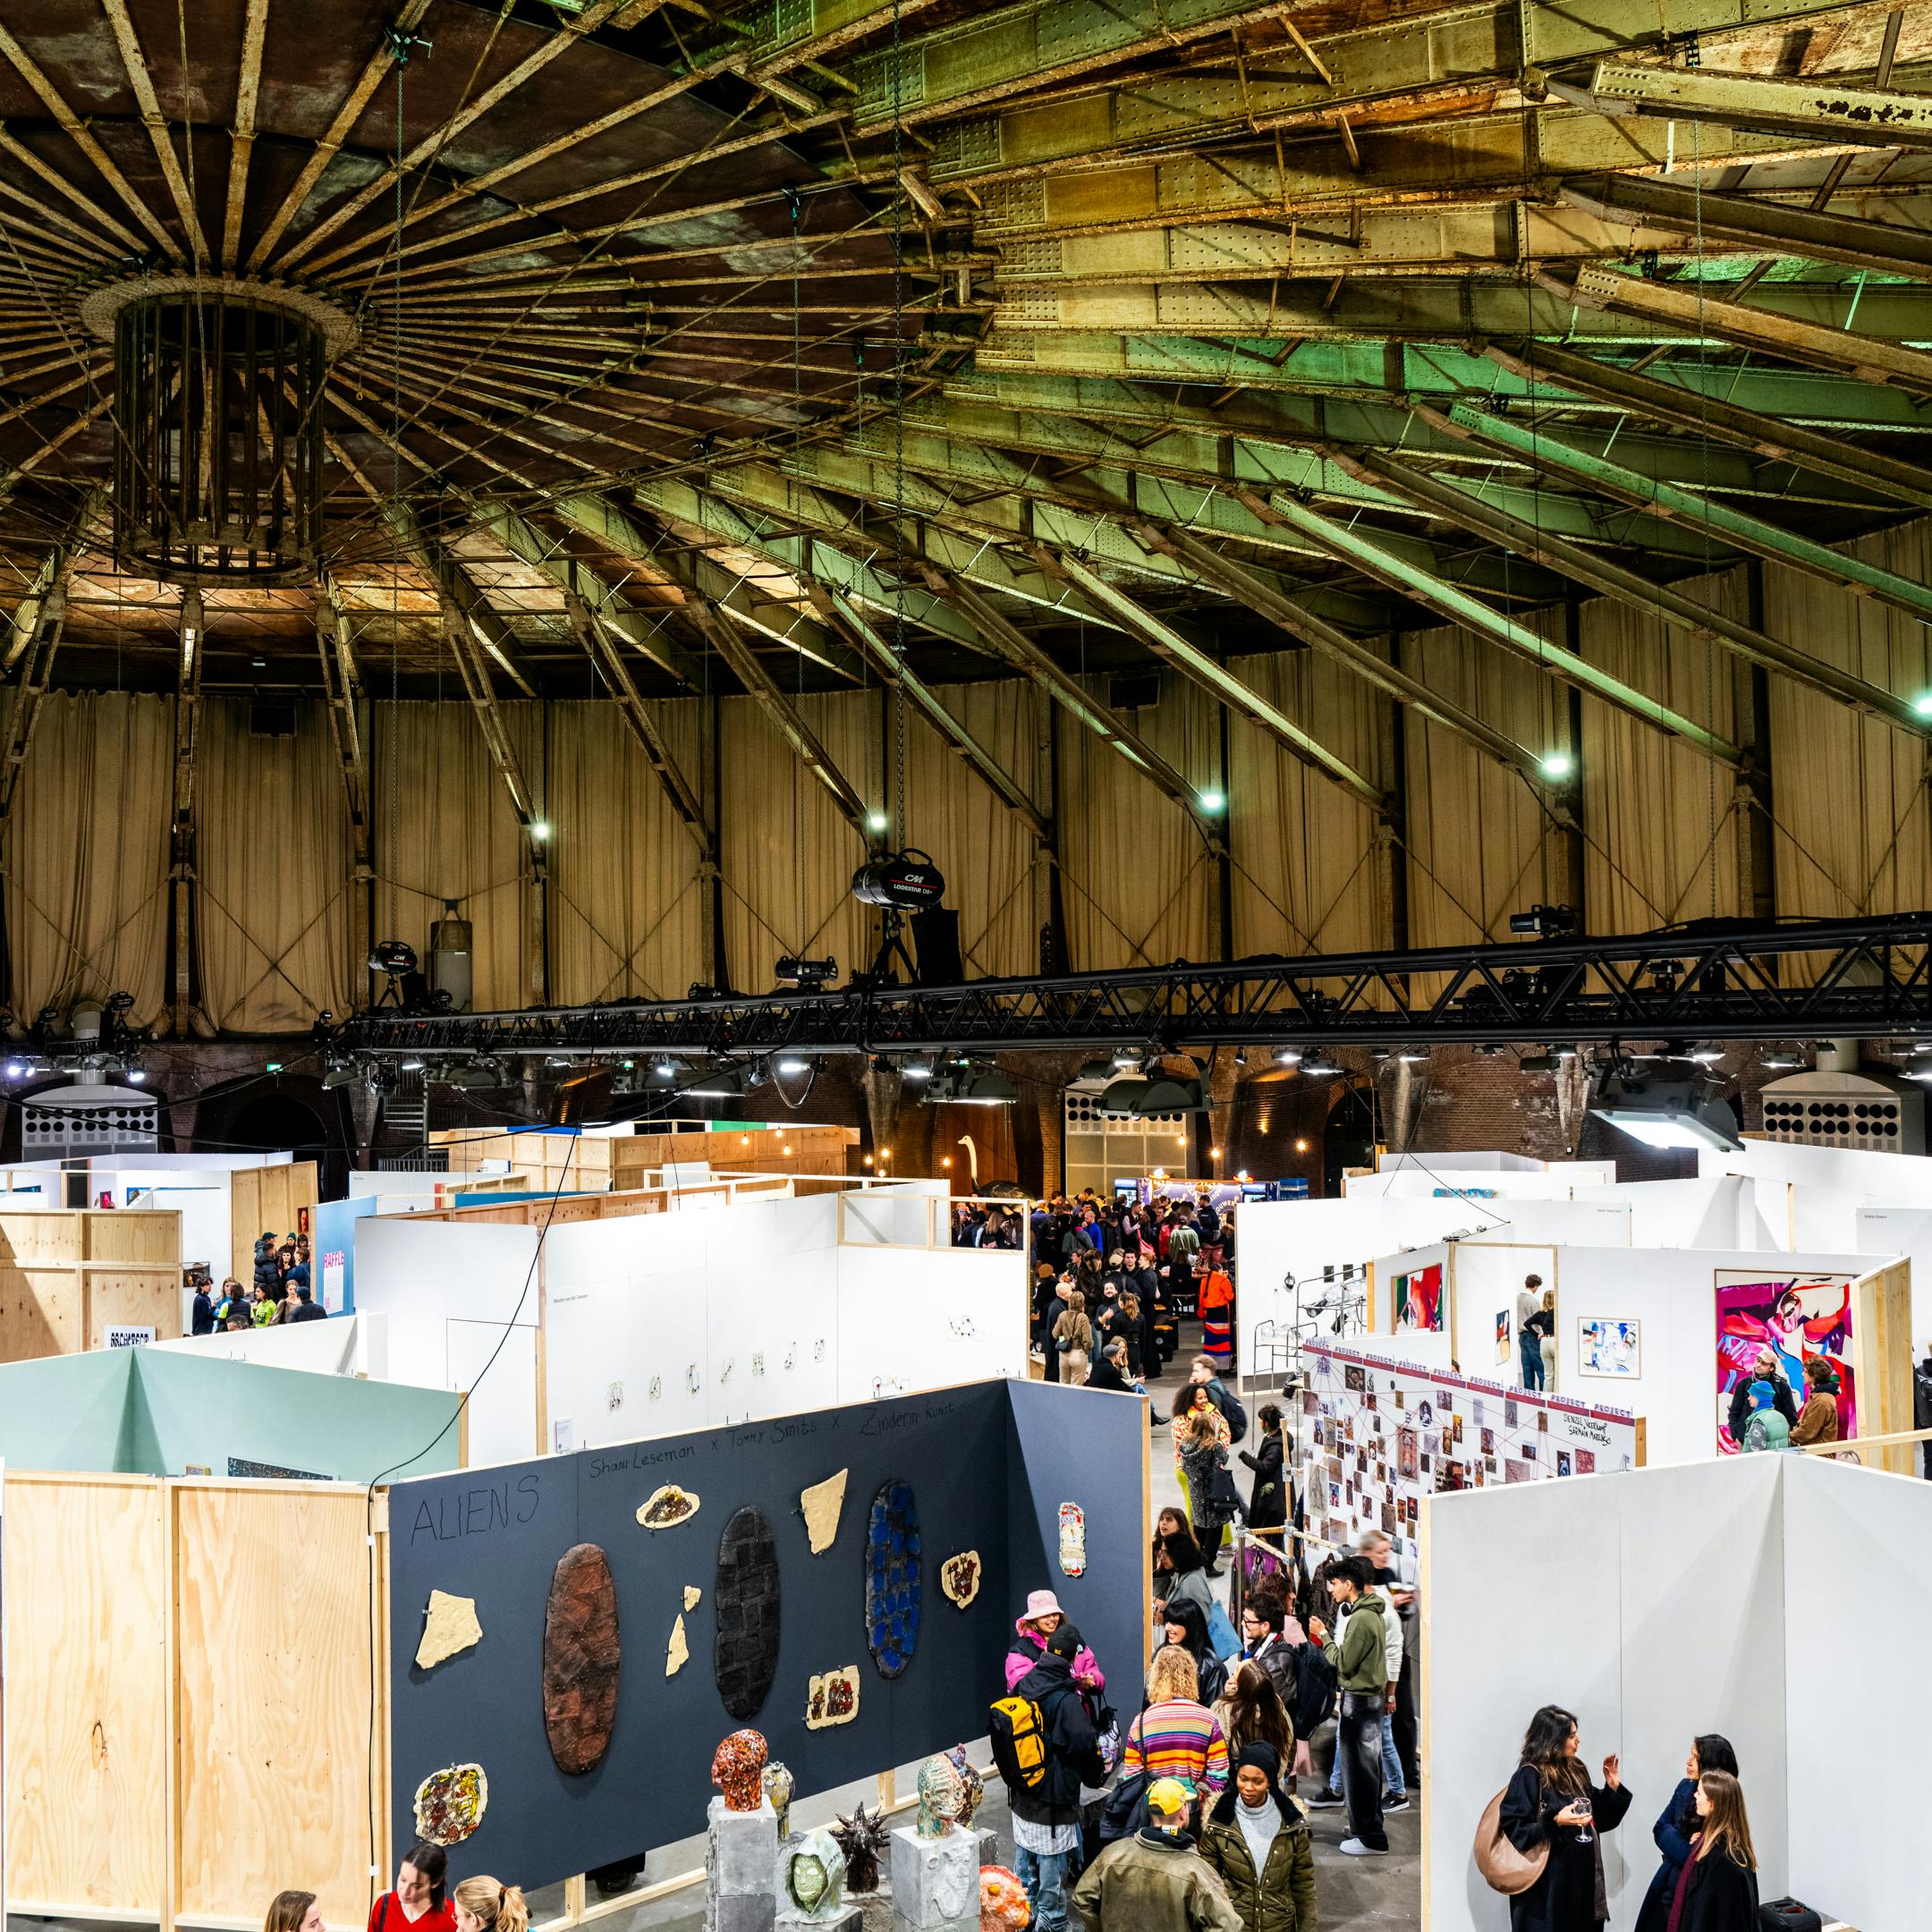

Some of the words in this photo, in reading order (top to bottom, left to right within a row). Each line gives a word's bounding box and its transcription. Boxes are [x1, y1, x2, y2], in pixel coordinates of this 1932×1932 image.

[904, 874, 924, 884] CM
[894, 884, 921, 894] LODESTAR
[323, 1251, 343, 1268] RAFFLE
[1335, 1346, 1360, 1357] PROJECT
[1366, 1352, 1392, 1364] PROJECT
[1398, 1360, 1427, 1372] PROJECT
[1433, 1368, 1462, 1380] PROJECT
[1470, 1376, 1501, 1389] PROJECT
[1509, 1385, 1542, 1398] PROJECT
[1551, 1394, 1586, 1408] PROJECT
[1594, 1403, 1631, 1418] PROJECT
[1563, 1413, 1583, 1427] DENZEL
[632, 1445, 695, 1469] Leseman
[770, 1416, 817, 1444] Smits
[411, 1475, 539, 1546] ALIENS
